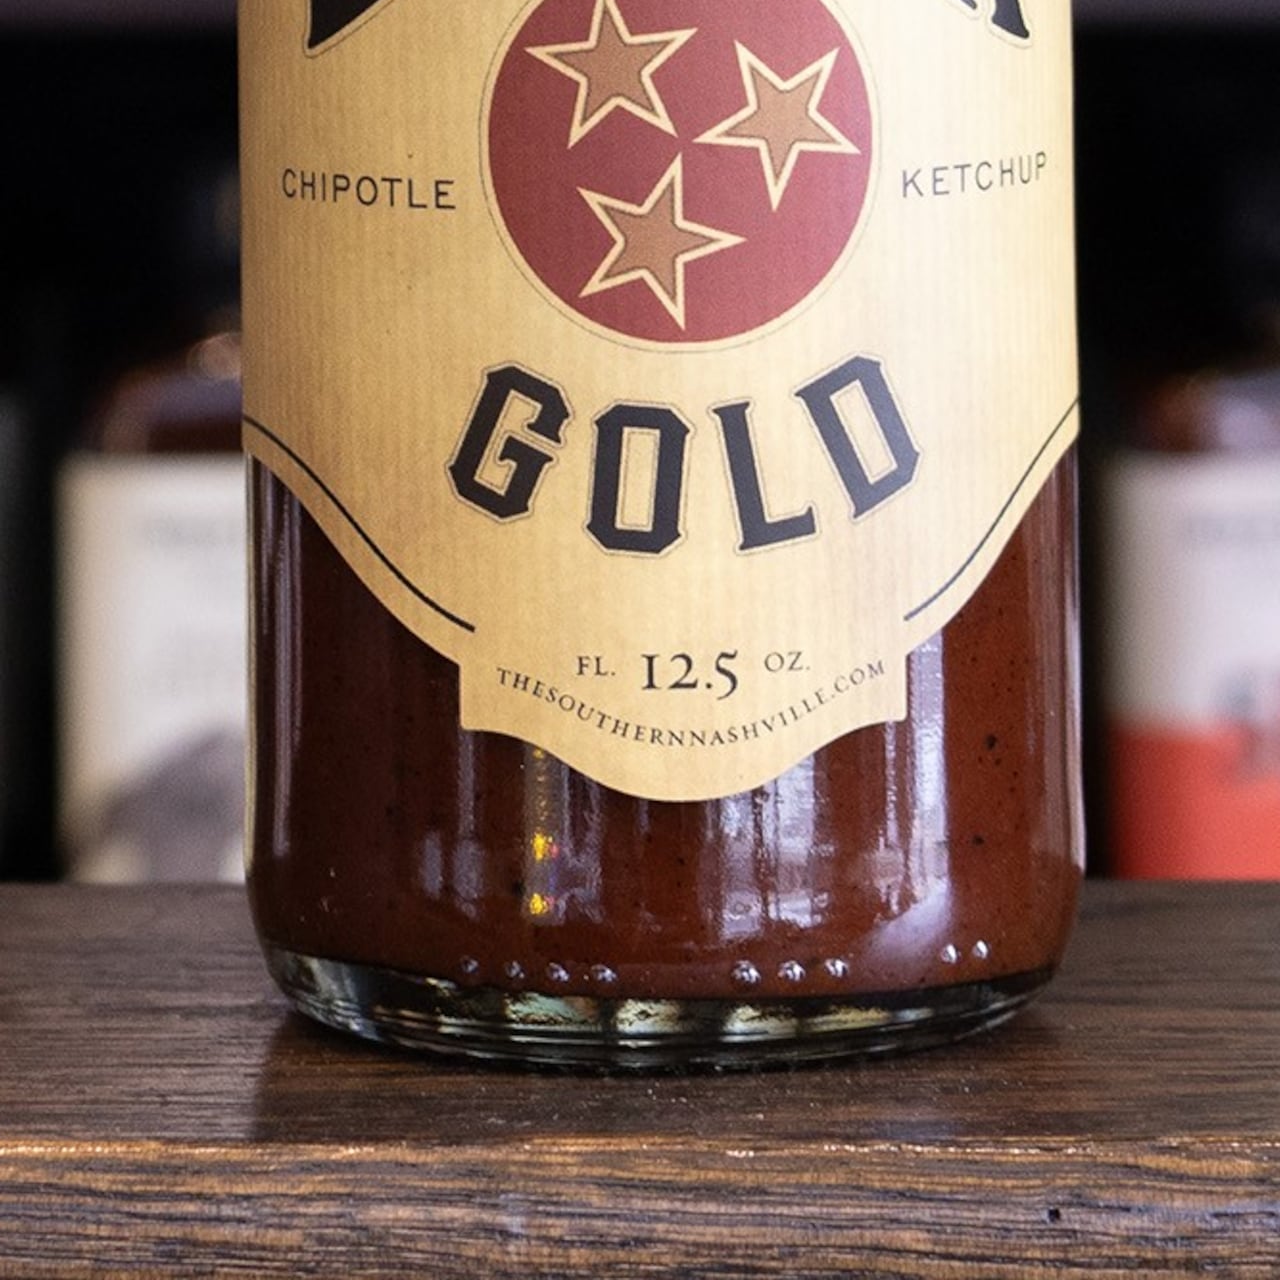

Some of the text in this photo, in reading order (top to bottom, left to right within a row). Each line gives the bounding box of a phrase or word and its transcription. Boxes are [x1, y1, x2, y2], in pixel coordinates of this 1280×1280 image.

[282, 168, 456, 210] CHIPOTLE
[902, 150, 1048, 198] KETCHUP
[448, 355, 921, 555] GOLD
[576, 649, 811, 700] FL. 12.5 OZ.
[496, 659, 886, 747] THESOUTHERNNASHVILLE.COM
